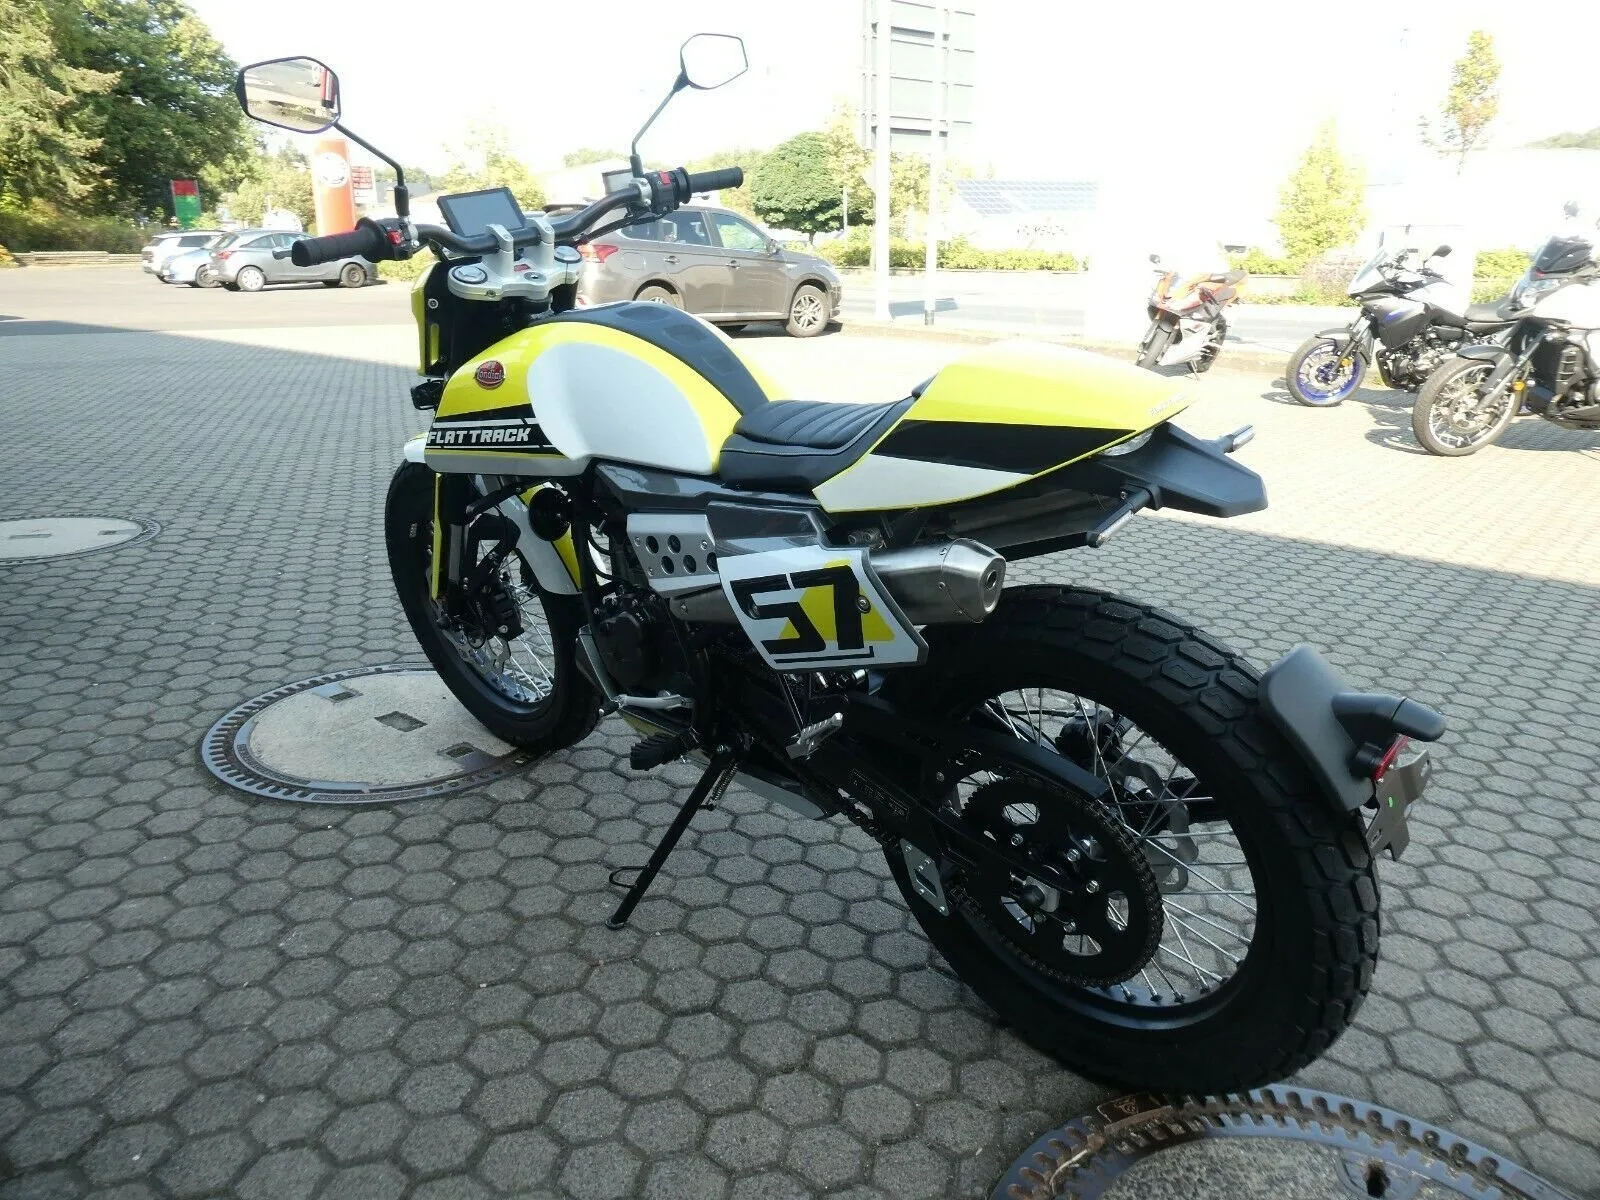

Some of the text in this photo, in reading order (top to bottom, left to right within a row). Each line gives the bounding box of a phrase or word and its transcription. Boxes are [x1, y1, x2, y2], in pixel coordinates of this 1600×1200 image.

[427, 428, 531, 444] FLAT TRACK
[730, 565, 864, 654] 57
